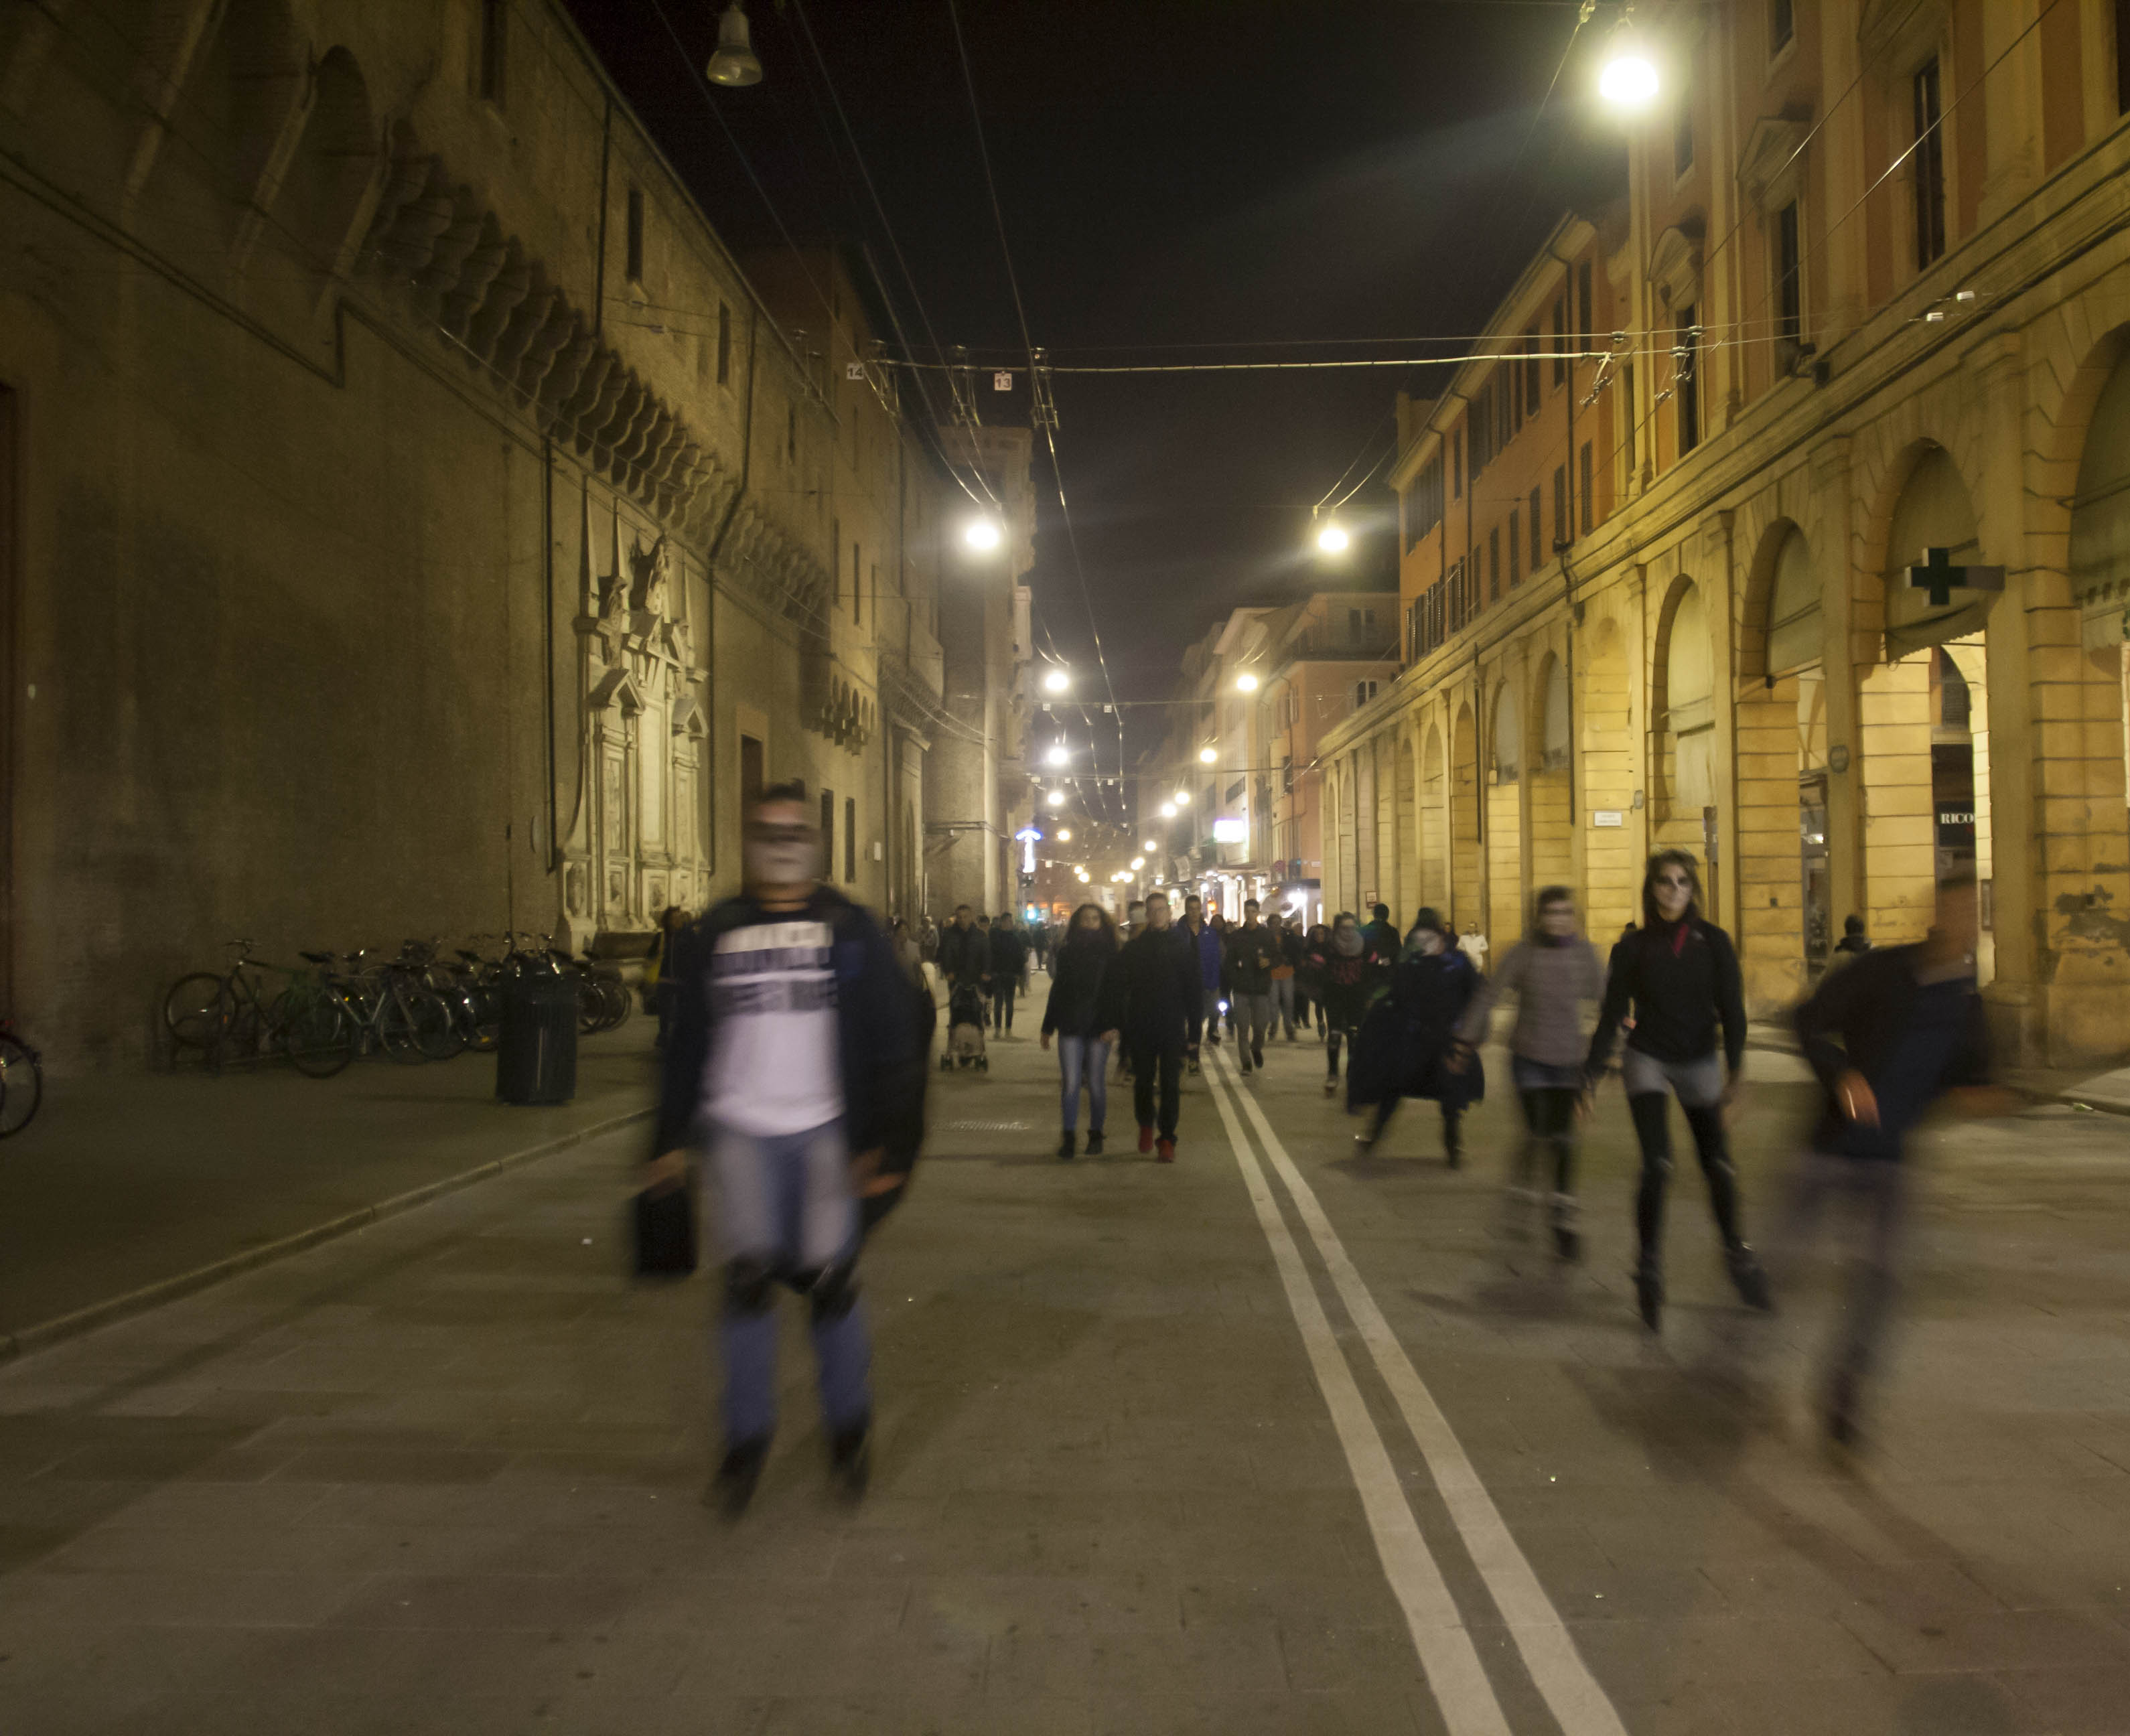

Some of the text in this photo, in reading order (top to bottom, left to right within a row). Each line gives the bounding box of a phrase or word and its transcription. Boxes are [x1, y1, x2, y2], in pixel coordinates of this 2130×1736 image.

[848, 368, 863, 376] 14
[995, 378, 1011, 388] 13
[1940, 813, 1974, 824] RICO
